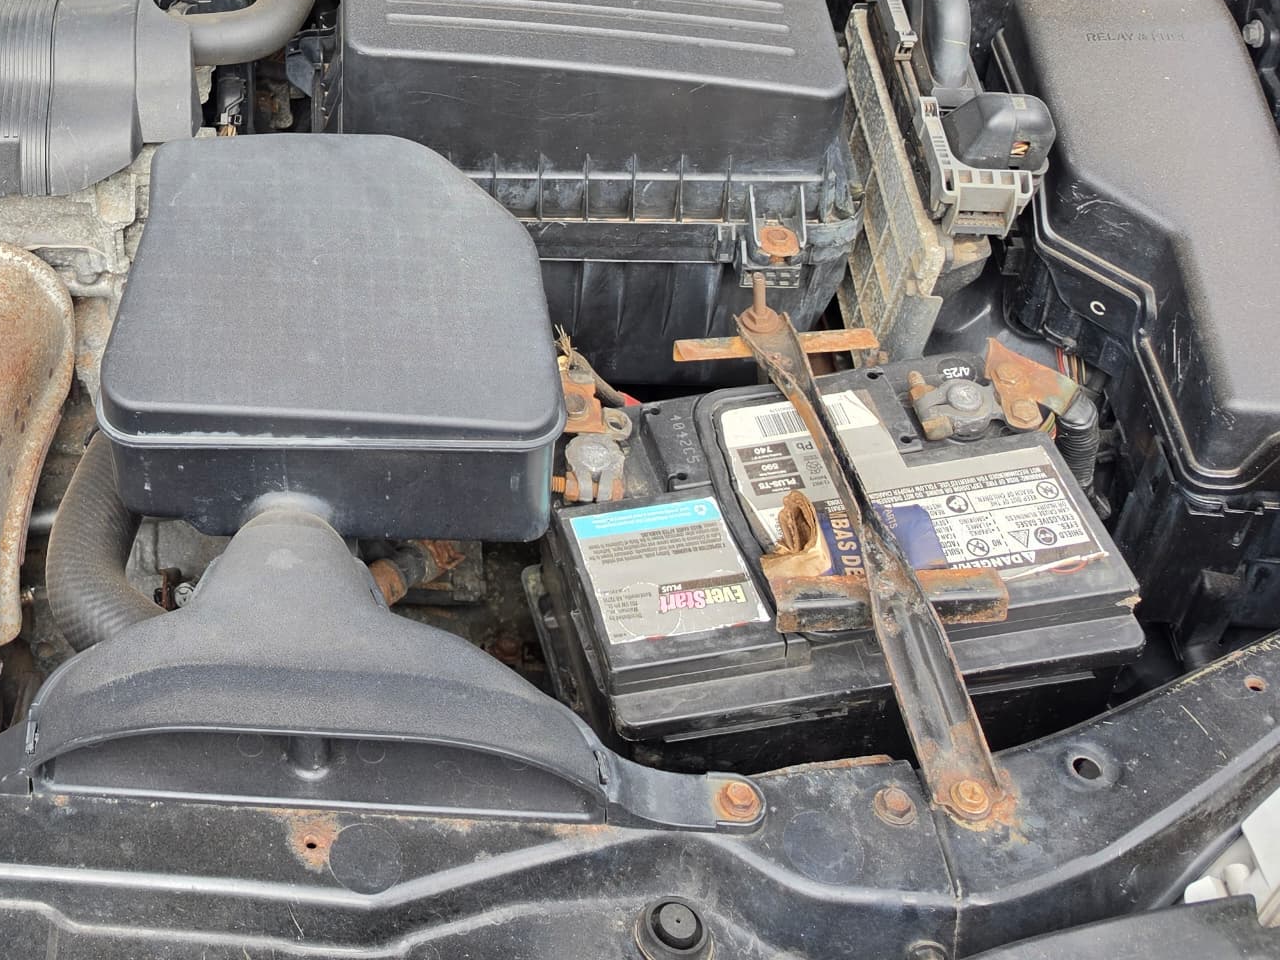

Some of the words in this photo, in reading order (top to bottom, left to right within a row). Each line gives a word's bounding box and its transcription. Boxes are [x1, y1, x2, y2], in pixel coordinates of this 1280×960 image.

[1086, 32, 1134, 42] RELAY
[943, 366, 970, 378] 4/25
[754, 446, 772, 454] 740
[1015, 518, 1036, 528] GASES
[1037, 513, 1074, 526] EXPLOSIVE
[1058, 528, 1084, 538] SHIELD
[661, 583, 682, 592] PLUS
[658, 586, 746, 612] EverStart
